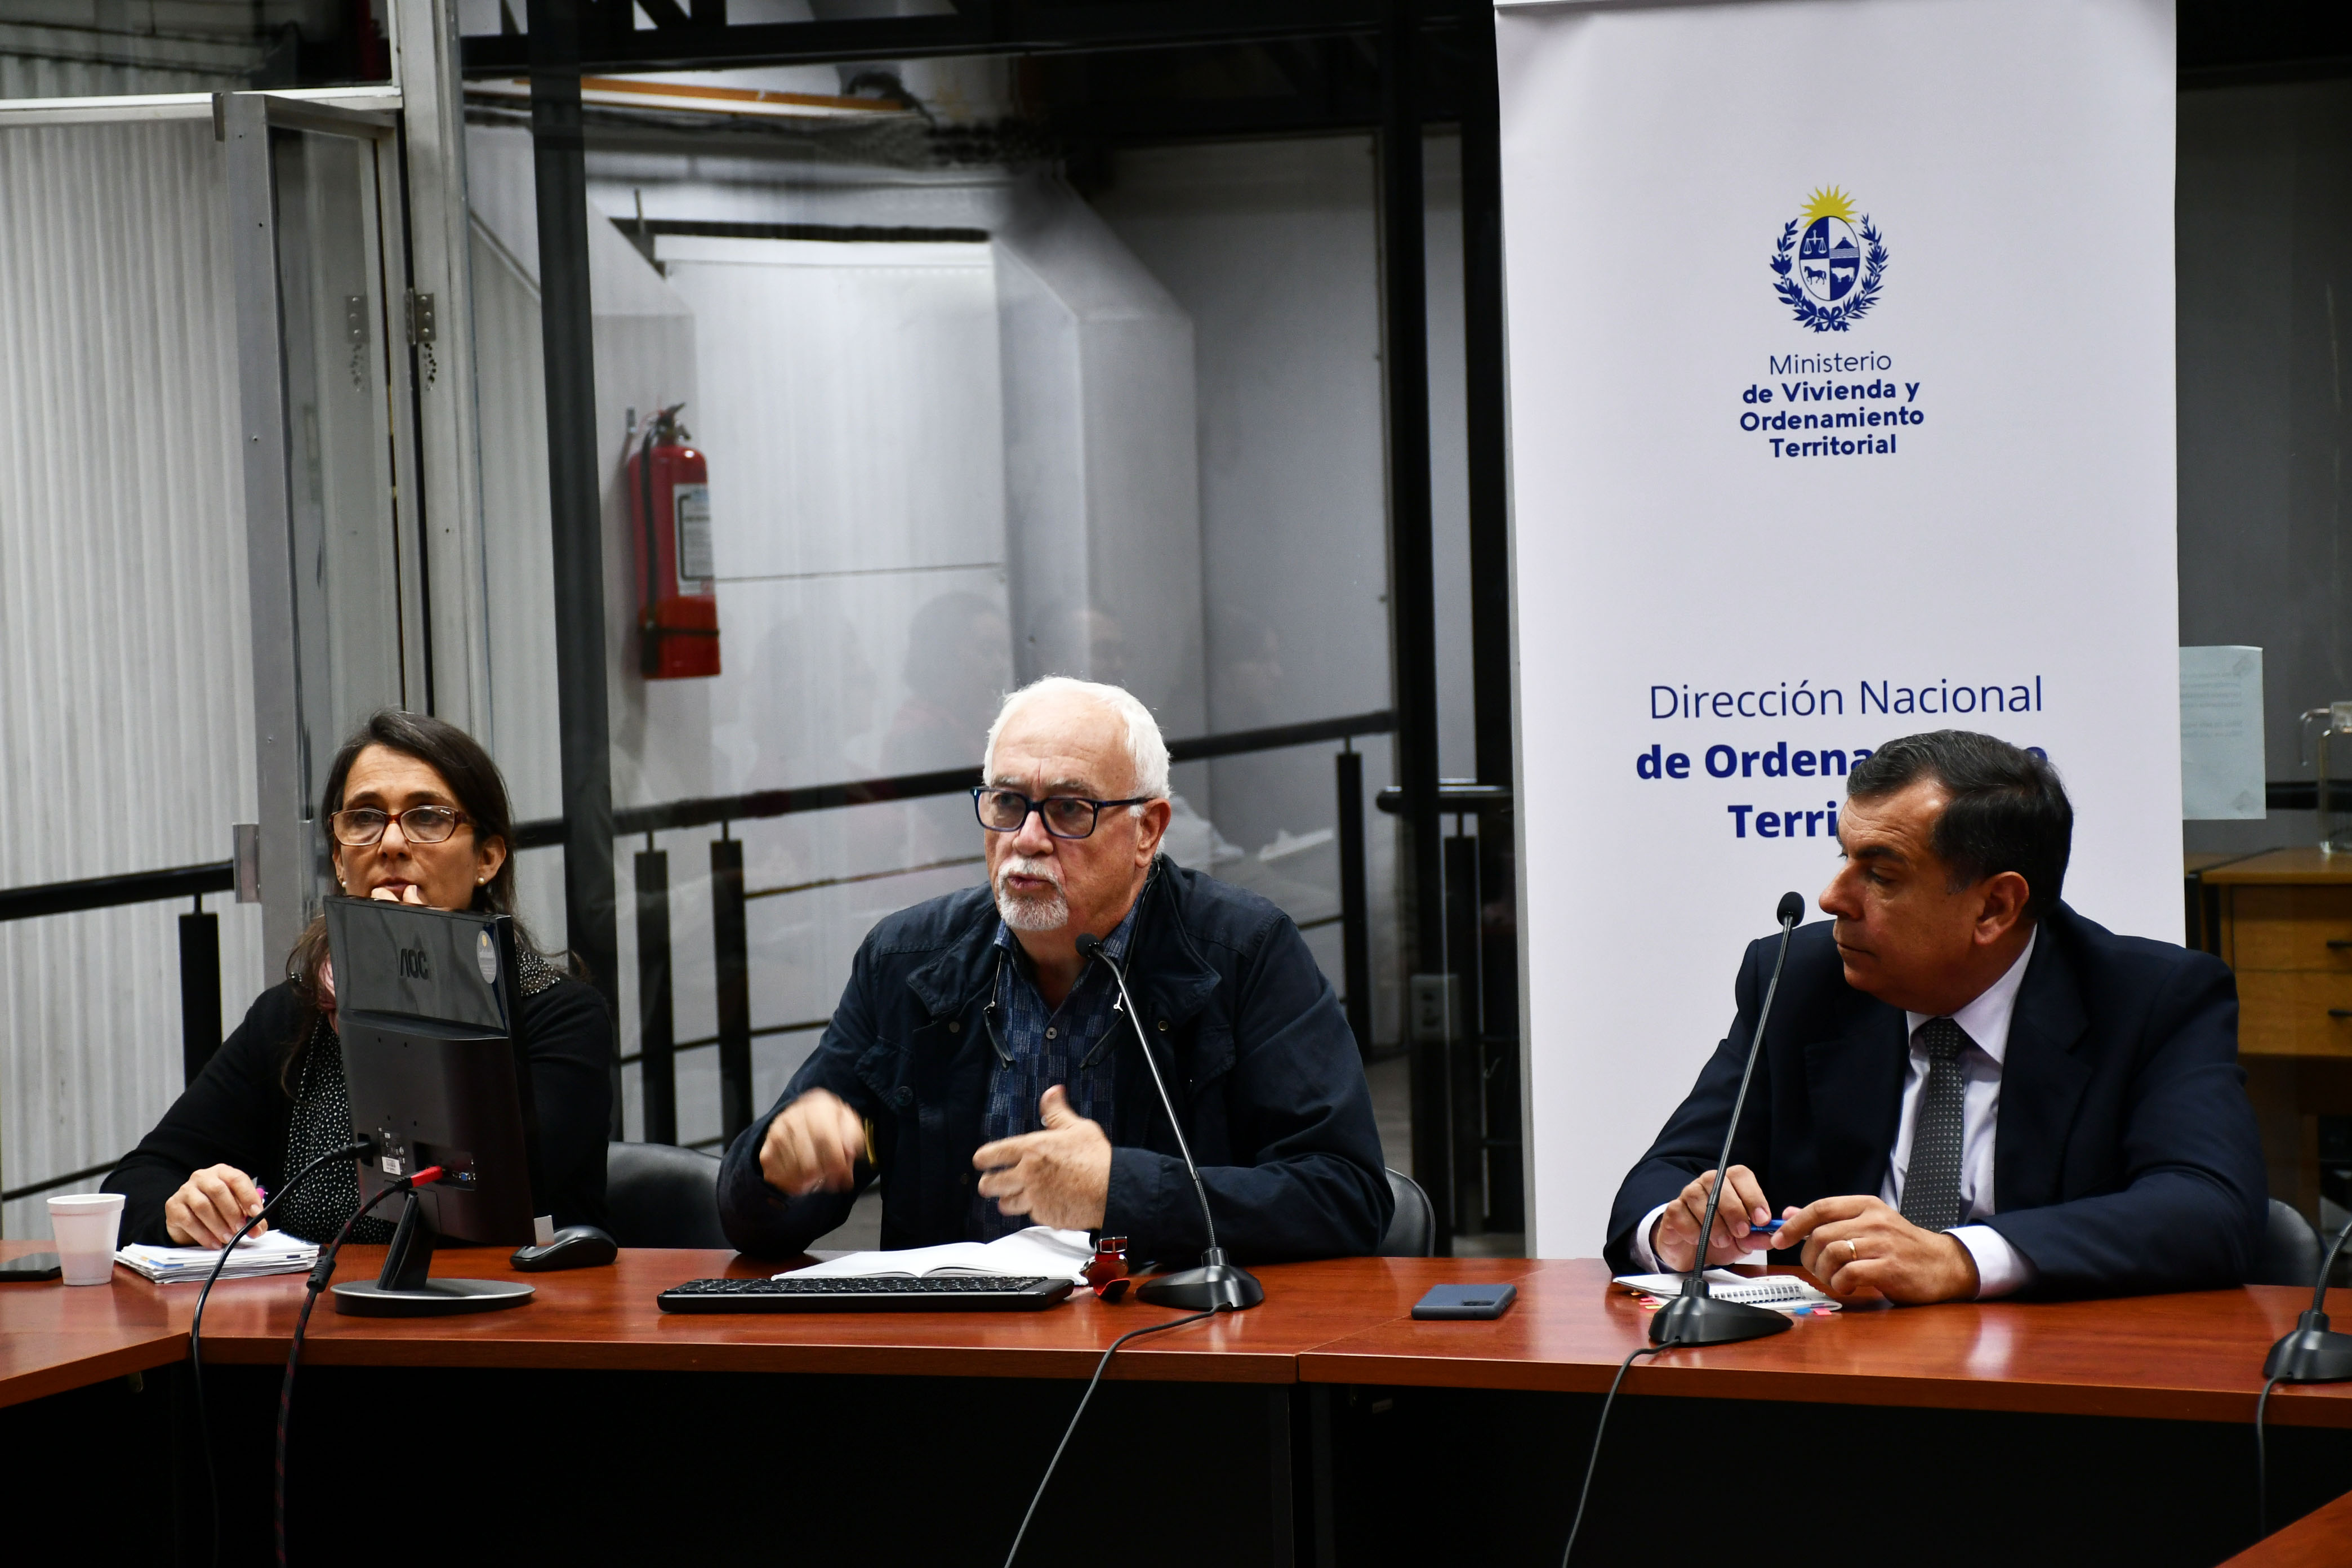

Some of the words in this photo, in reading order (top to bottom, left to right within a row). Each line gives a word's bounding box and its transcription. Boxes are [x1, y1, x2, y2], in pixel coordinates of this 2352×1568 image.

[1770, 350, 1892, 375] Ministerio
[1742, 384, 1773, 404] de
[1781, 379, 1896, 403] Vivienda
[1905, 381, 1921, 403] y
[1740, 406, 1925, 432] Ordenamiento
[1769, 433, 1896, 458] Territorial
[1651, 679, 1843, 719] Dirección
[1860, 675, 2042, 715] Nacional
[1636, 743, 1691, 780] de
[400, 948, 429, 979] AOC
